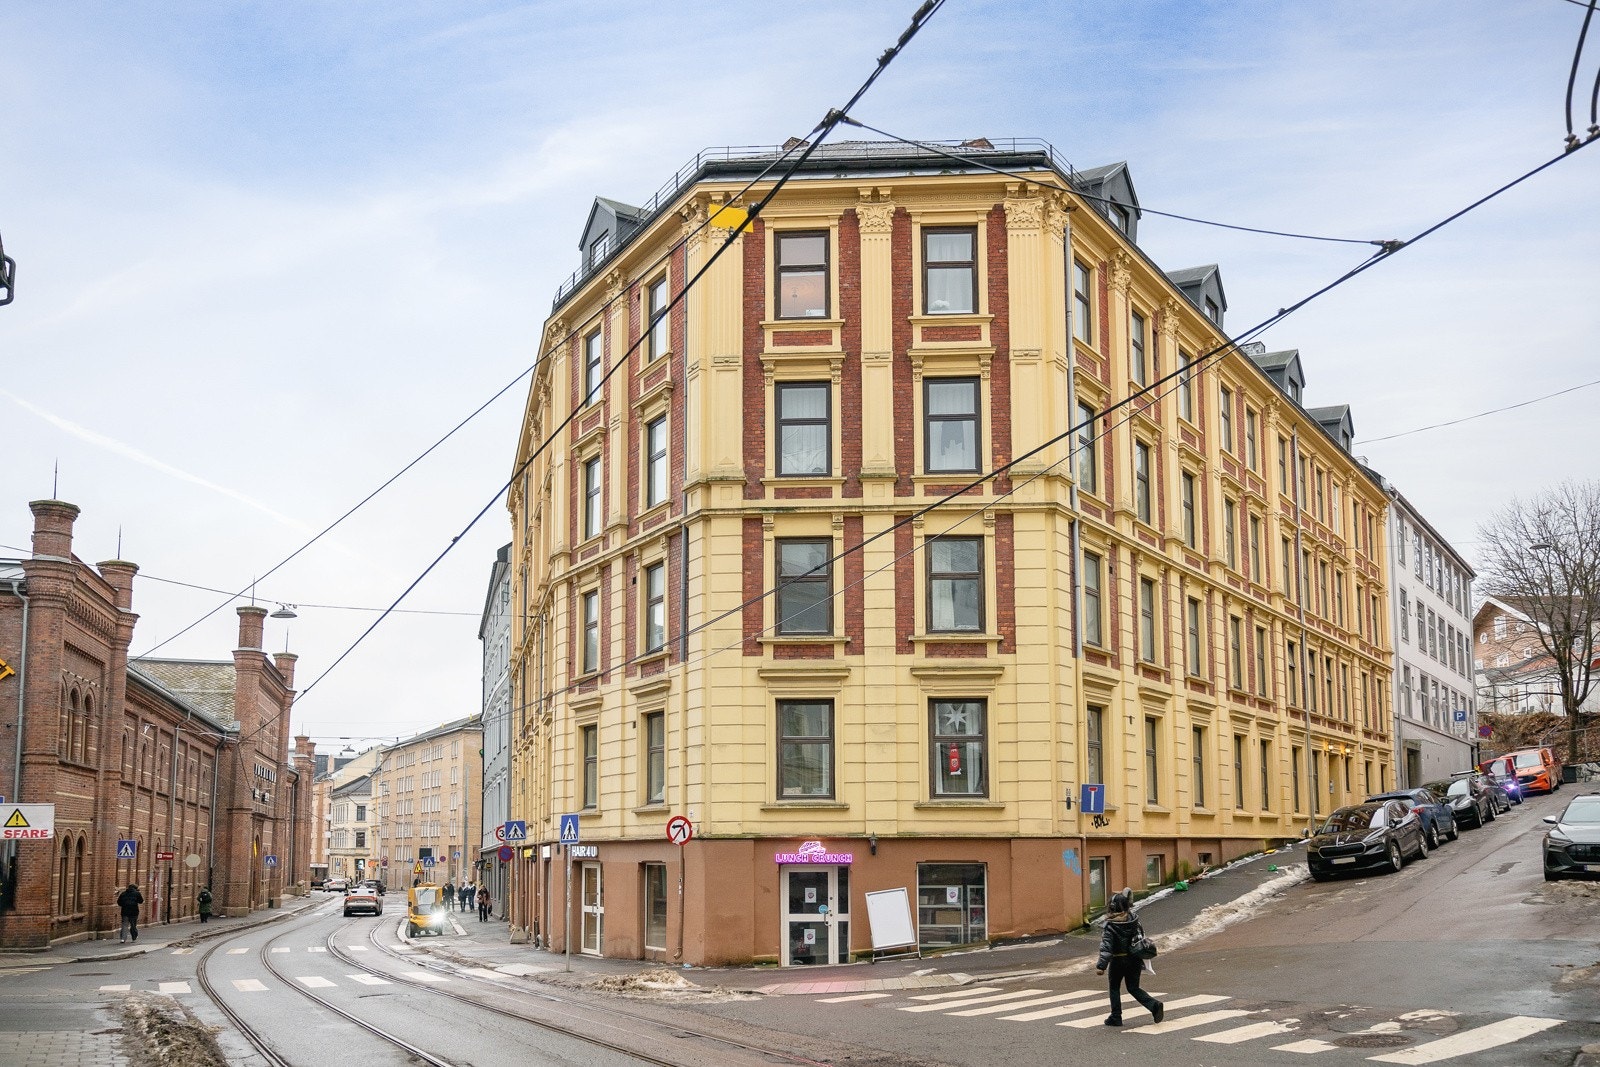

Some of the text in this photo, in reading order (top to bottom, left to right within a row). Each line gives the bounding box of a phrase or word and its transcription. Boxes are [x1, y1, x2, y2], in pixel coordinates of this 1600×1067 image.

[1456, 712, 1463, 720] P
[4, 829, 48, 839] SFARE
[775, 853, 853, 863] LUNCH CRUNCH
